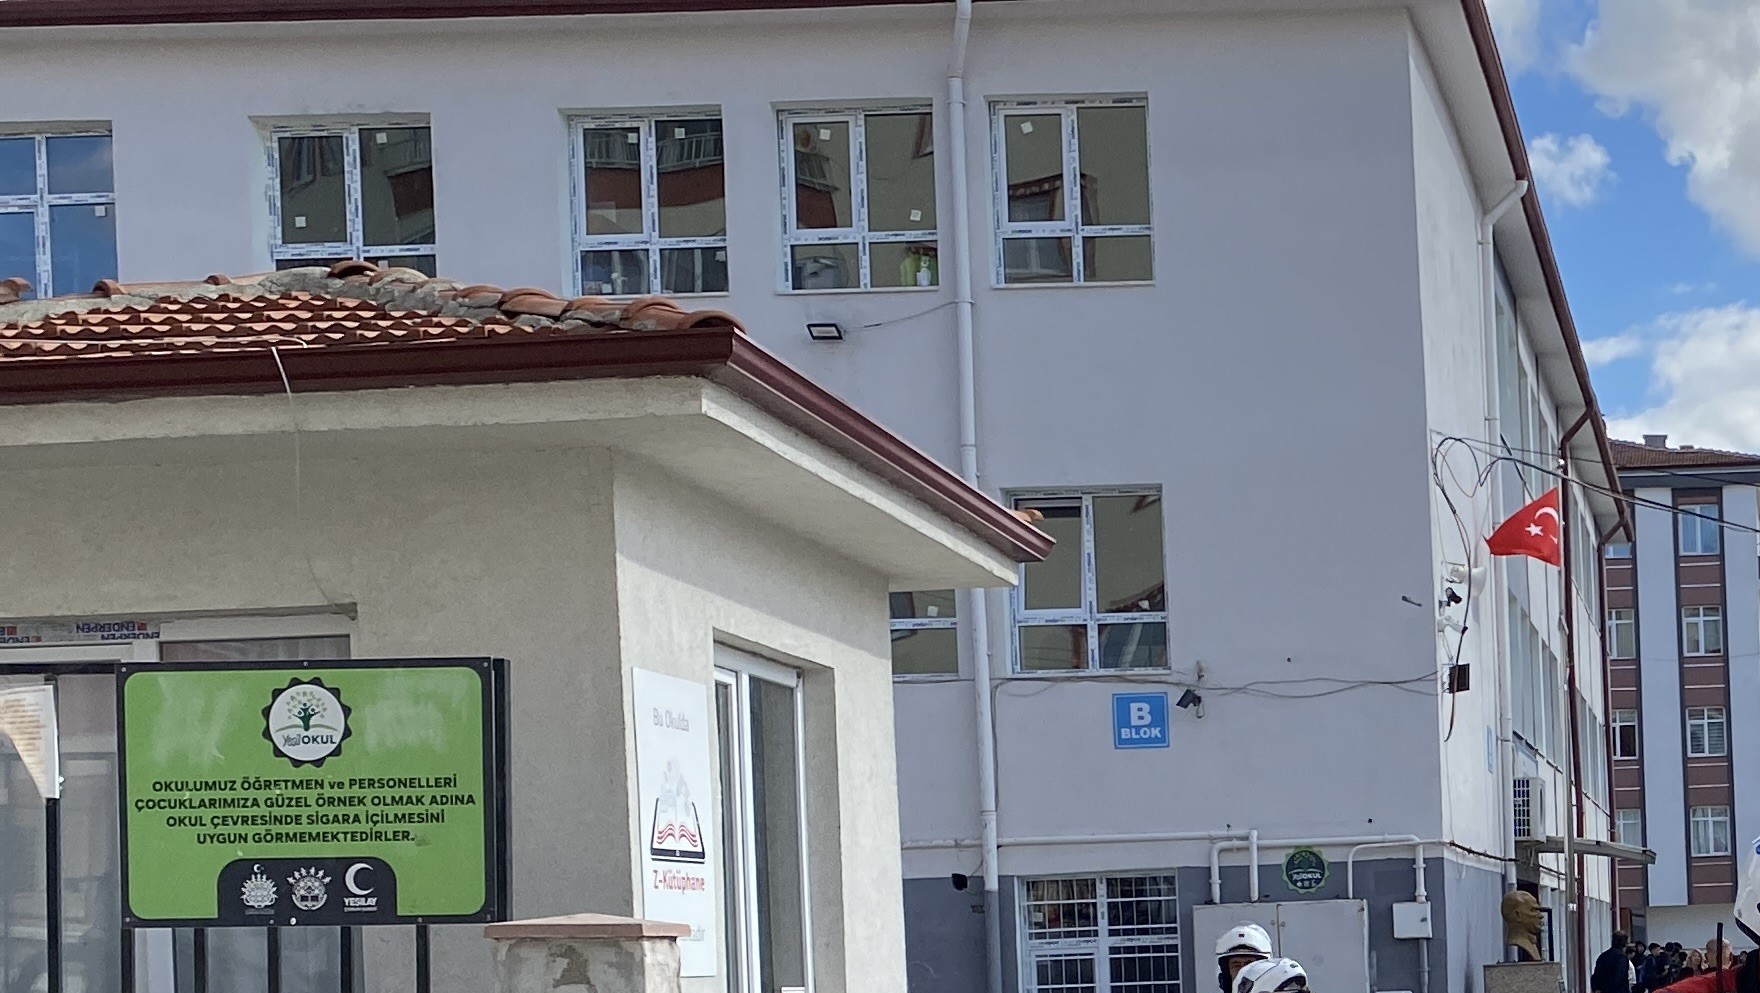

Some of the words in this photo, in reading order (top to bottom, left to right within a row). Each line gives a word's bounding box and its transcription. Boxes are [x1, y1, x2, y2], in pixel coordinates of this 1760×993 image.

[1129, 702, 1152, 726] B
[1119, 726, 1162, 739] BLOK
[152, 779, 237, 792] OKULUMUZ
[240, 776, 325, 791] ÖĞRETMEN
[328, 780, 345, 790] ve
[348, 773, 458, 790] PERSONELLERİ
[134, 797, 261, 812] ÇOCUKLARIMIZA
[264, 793, 312, 808] GÜZEL
[315, 792, 367, 808] ÖRNEK
[370, 794, 426, 807] OLMAK
[428, 794, 477, 806] ADINA
[166, 815, 207, 827] OKUL
[210, 811, 303, 829] ÇEVRESİNDE
[306, 810, 362, 825] SİGARA
[365, 808, 445, 827] İÇİLMESİNİ
[196, 832, 249, 844] UYGUN
[252, 827, 416, 844] GÖRMEMEKTEDİRLER.
